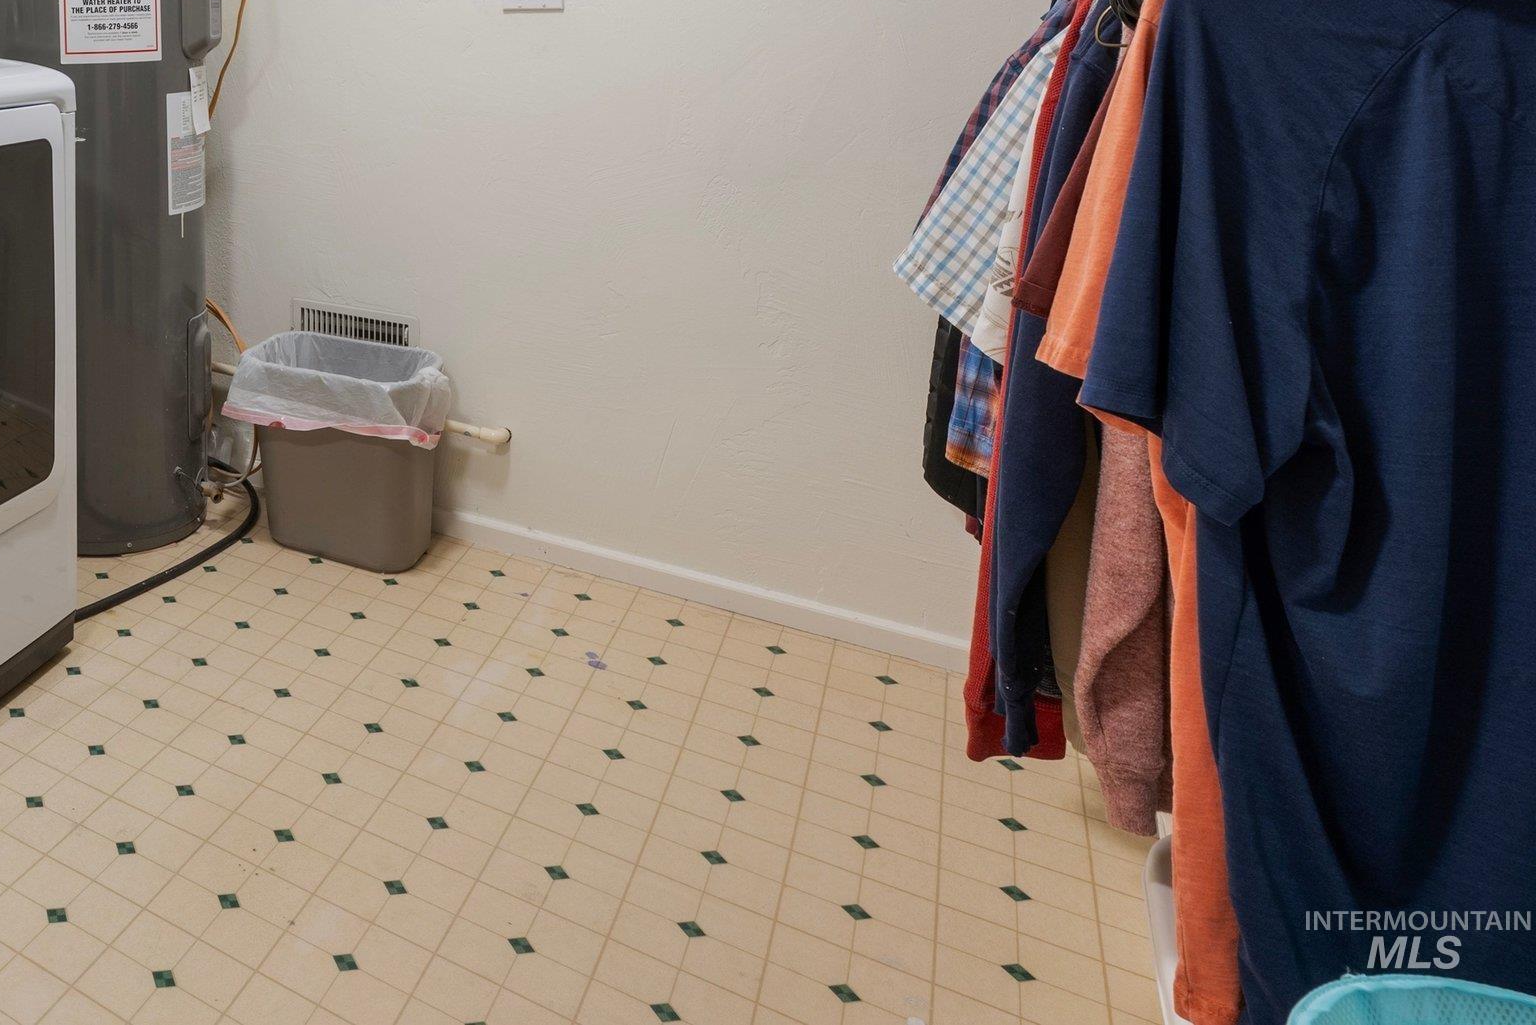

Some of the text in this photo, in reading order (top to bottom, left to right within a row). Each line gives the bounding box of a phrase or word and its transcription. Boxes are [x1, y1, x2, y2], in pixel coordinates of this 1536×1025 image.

[86, 6, 107, 14] PLACE
[109, 5, 118, 13] OF
[119, 5, 151, 13] PURCHASE
